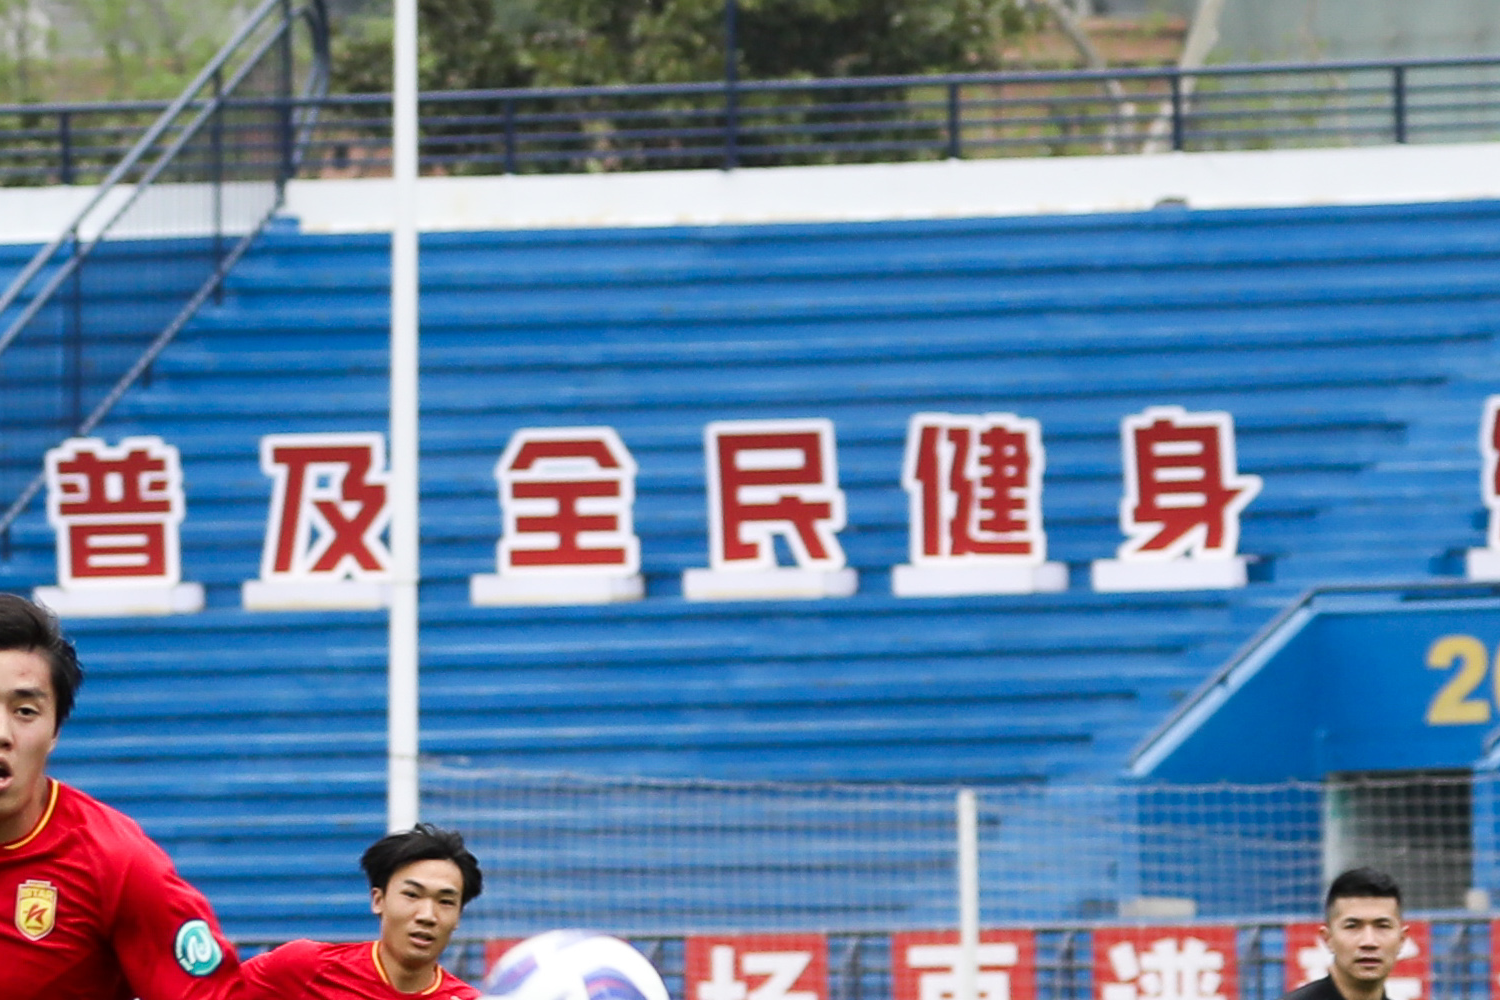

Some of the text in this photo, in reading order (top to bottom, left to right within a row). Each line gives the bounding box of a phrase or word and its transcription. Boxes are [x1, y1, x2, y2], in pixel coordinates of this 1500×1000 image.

[46, 408, 1264, 588] 普及全民健身
[1424, 633, 1500, 726] 2
